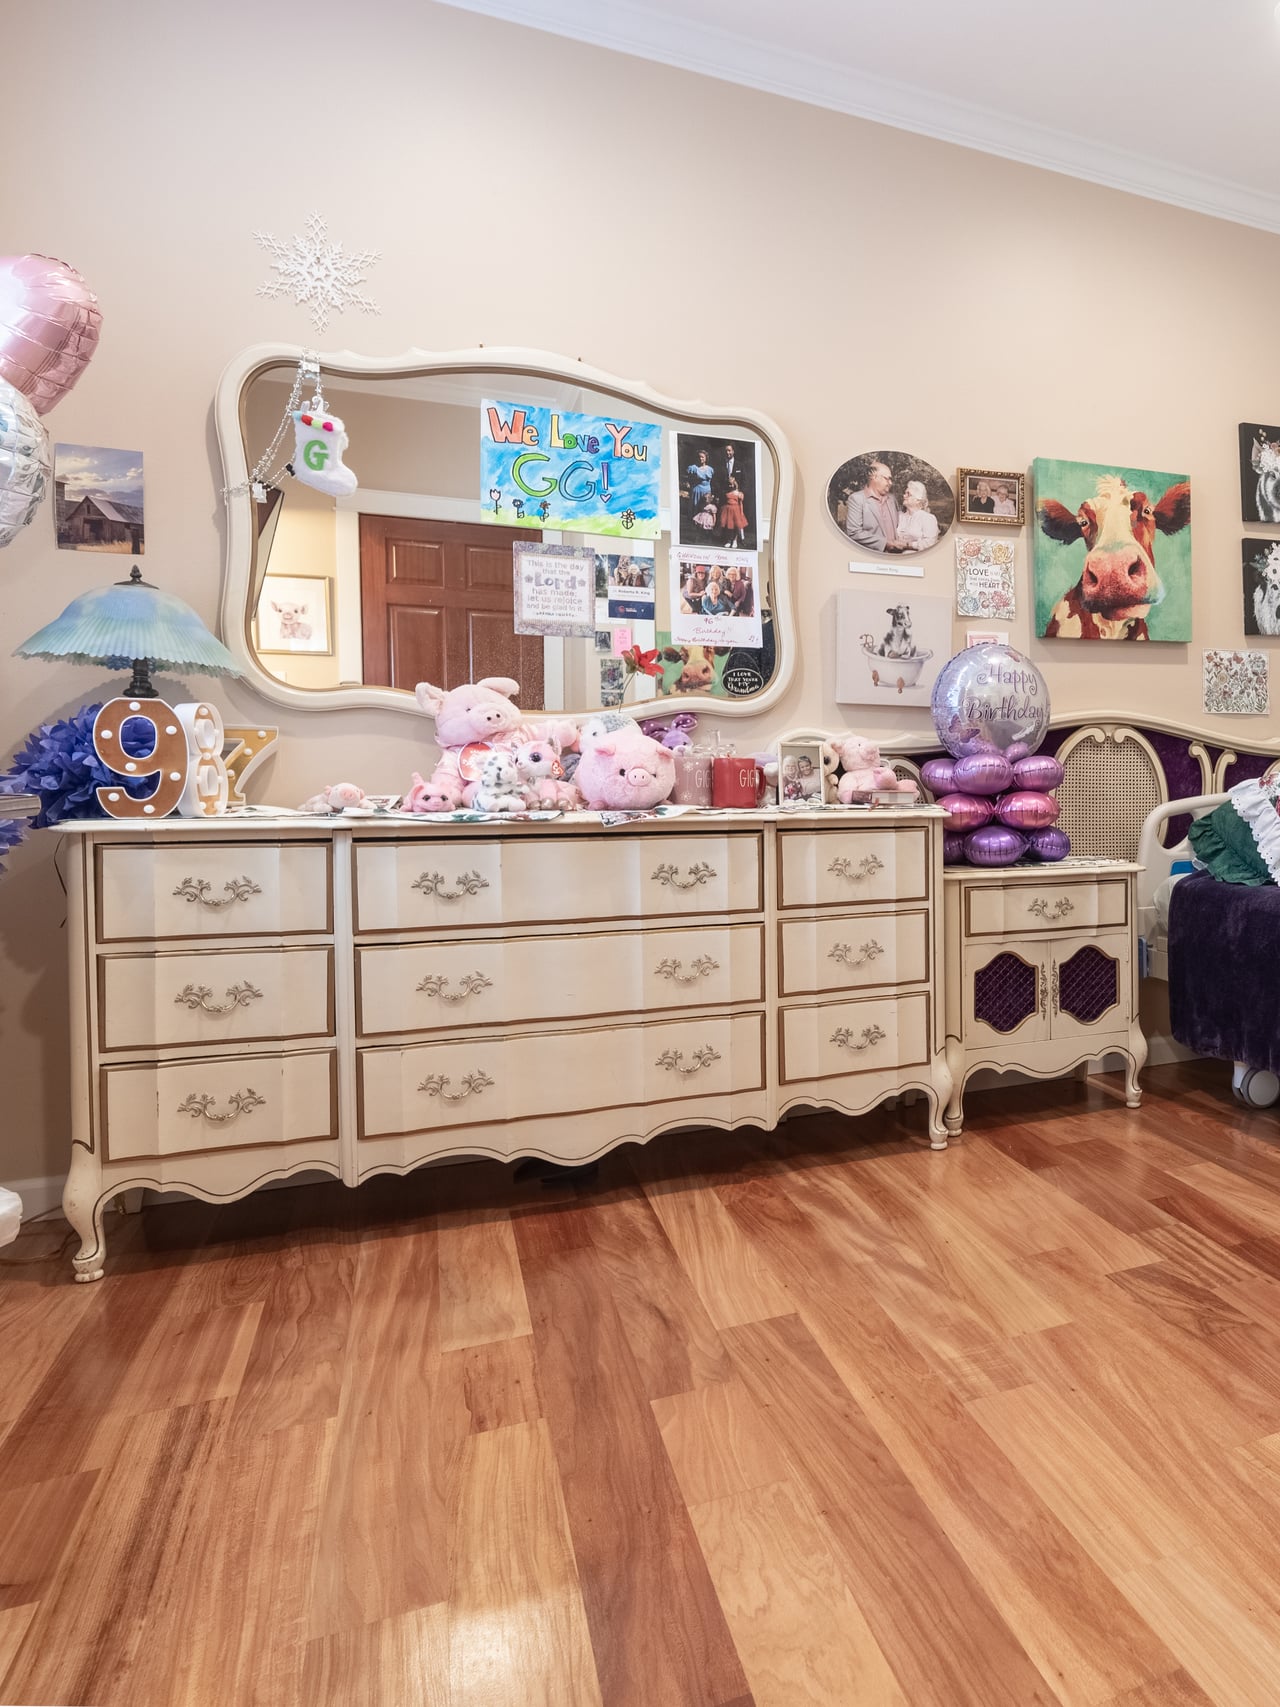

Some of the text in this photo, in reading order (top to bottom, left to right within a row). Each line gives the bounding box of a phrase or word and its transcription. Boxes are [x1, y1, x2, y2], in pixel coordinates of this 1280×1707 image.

[487, 407, 648, 462] We Love You
[303, 439, 330, 471] G
[512, 452, 612, 503] GG!
[535, 572, 577, 590] Lord
[969, 568, 989, 577] LOVE
[979, 581, 1000, 589] HEART
[977, 663, 1038, 695] Happy
[93, 697, 189, 820] 9
